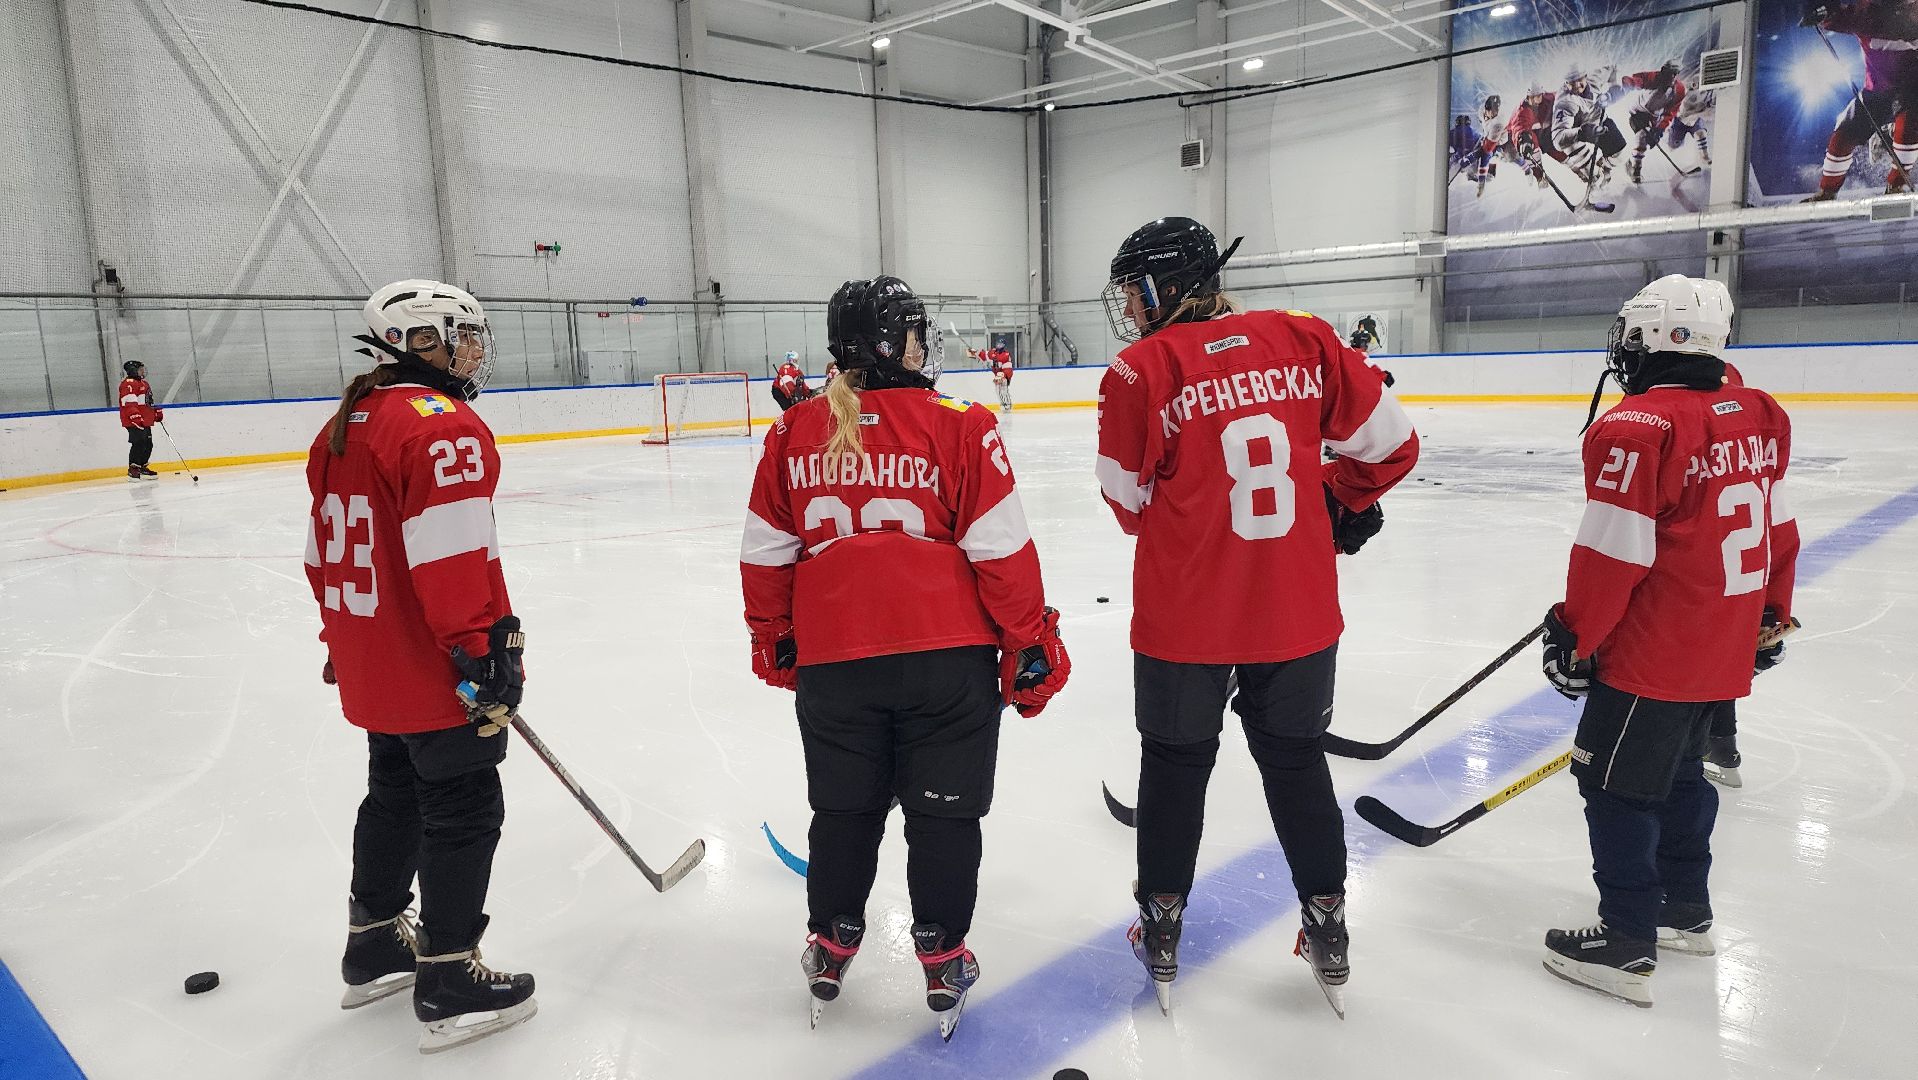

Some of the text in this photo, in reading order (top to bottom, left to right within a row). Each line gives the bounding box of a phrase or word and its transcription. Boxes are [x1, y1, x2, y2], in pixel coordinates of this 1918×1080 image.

[1147, 251, 1179, 261] BAUER
[905, 314, 921, 322] CCM
[428, 436, 485, 488] 23
[787, 451, 940, 498] ИЛОВАНОВА
[1220, 412, 1296, 541] 8
[1594, 446, 1640, 494] 21
[319, 493, 379, 618] 23
[838, 922, 862, 932] CCM
[915, 930, 937, 938] CCM
